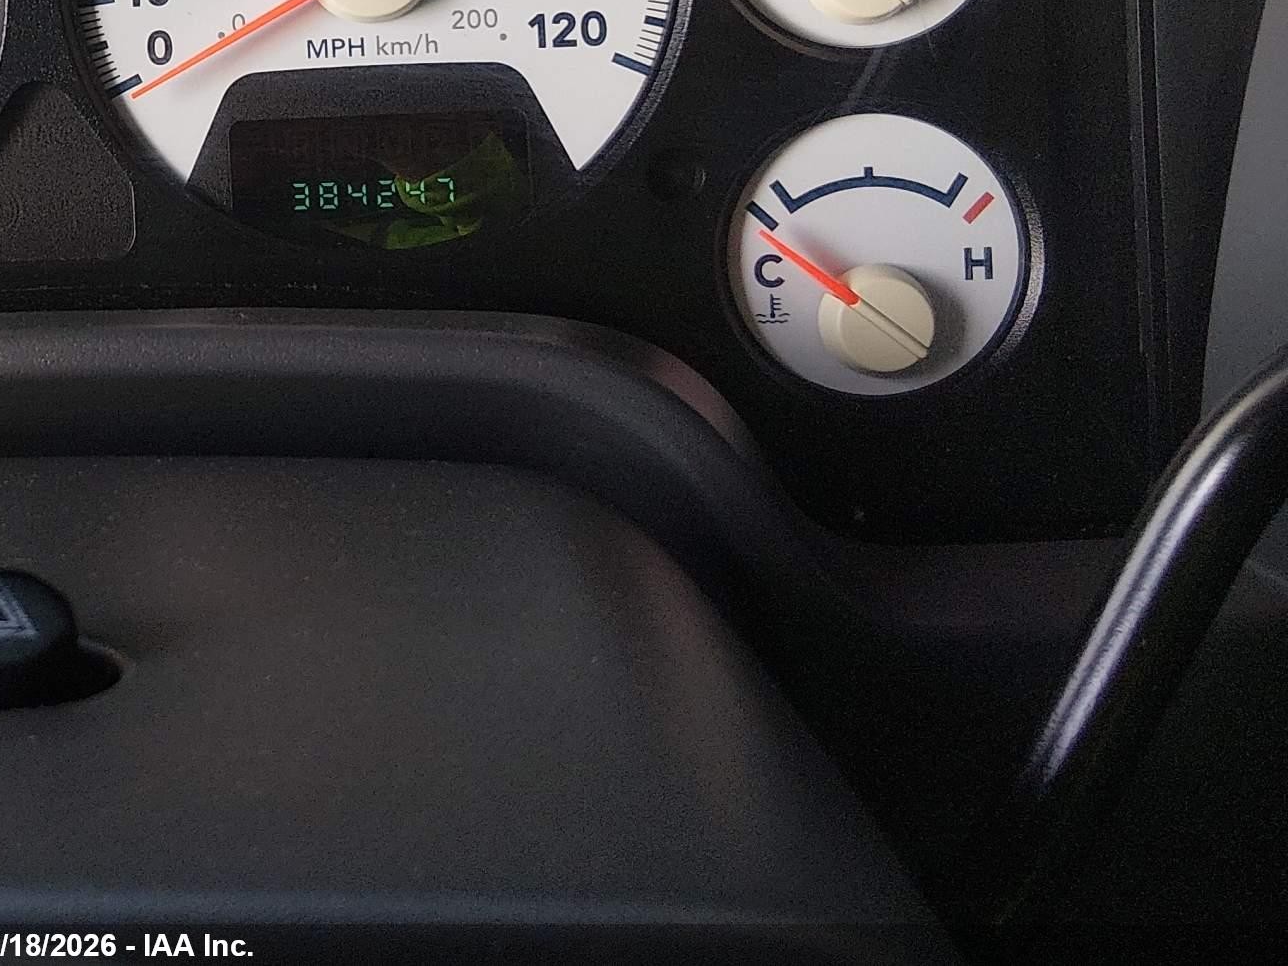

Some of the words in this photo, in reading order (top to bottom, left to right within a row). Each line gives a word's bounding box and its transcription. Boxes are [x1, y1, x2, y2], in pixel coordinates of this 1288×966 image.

[450, 7, 499, 32] 200
[528, 10, 607, 51] 120
[146, 30, 174, 66] 0
[305, 37, 366, 60] MPH
[375, 34, 439, 58] km/h
[292, 178, 455, 211] 384247
[753, 253, 786, 288] C
[964, 246, 994, 280] H
